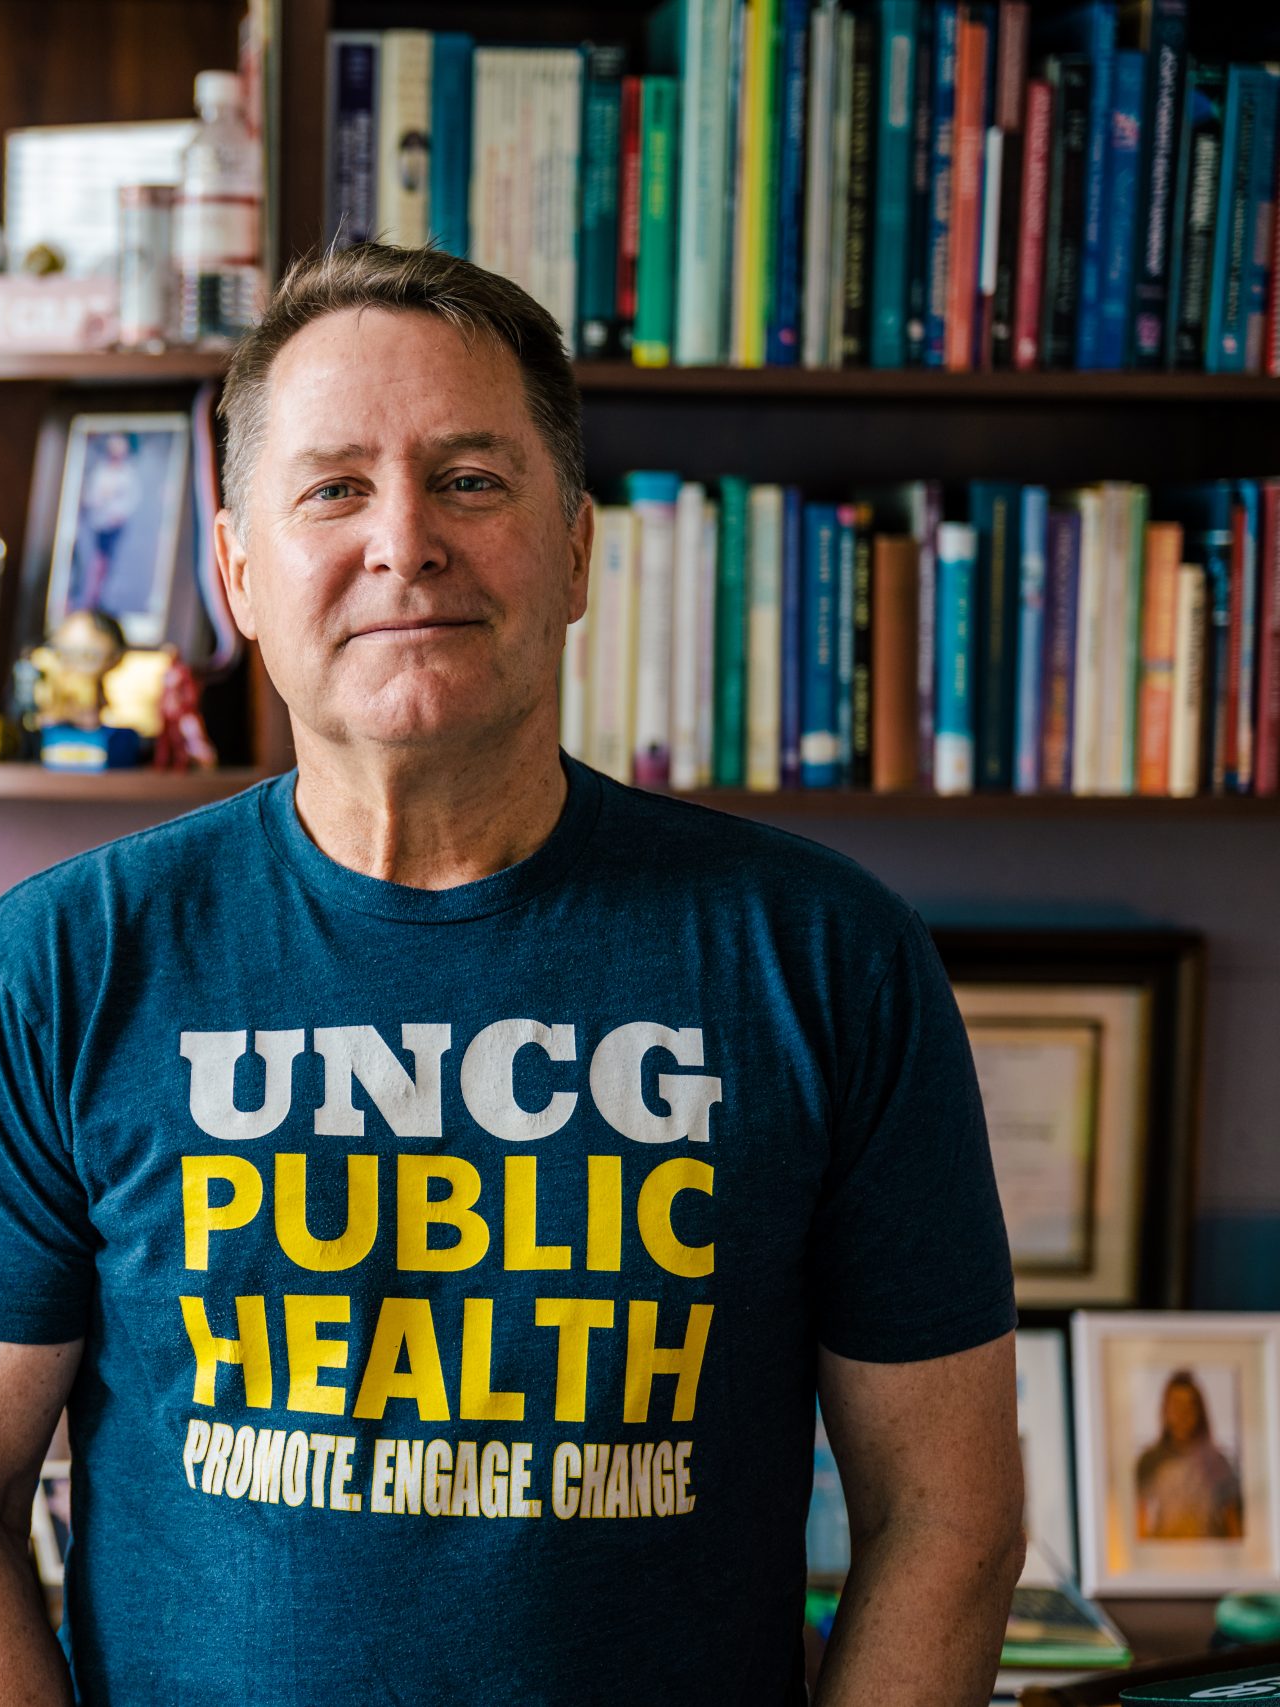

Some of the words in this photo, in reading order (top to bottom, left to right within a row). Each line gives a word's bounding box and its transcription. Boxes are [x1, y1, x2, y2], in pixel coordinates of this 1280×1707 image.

[179, 1018, 723, 1144] UNCG
[180, 1152, 716, 1278] PUBLIC
[178, 1294, 716, 1424] HEALTH
[182, 1418, 363, 1512] PROMOTE.
[370, 1437, 543, 1519] ENGAGE.
